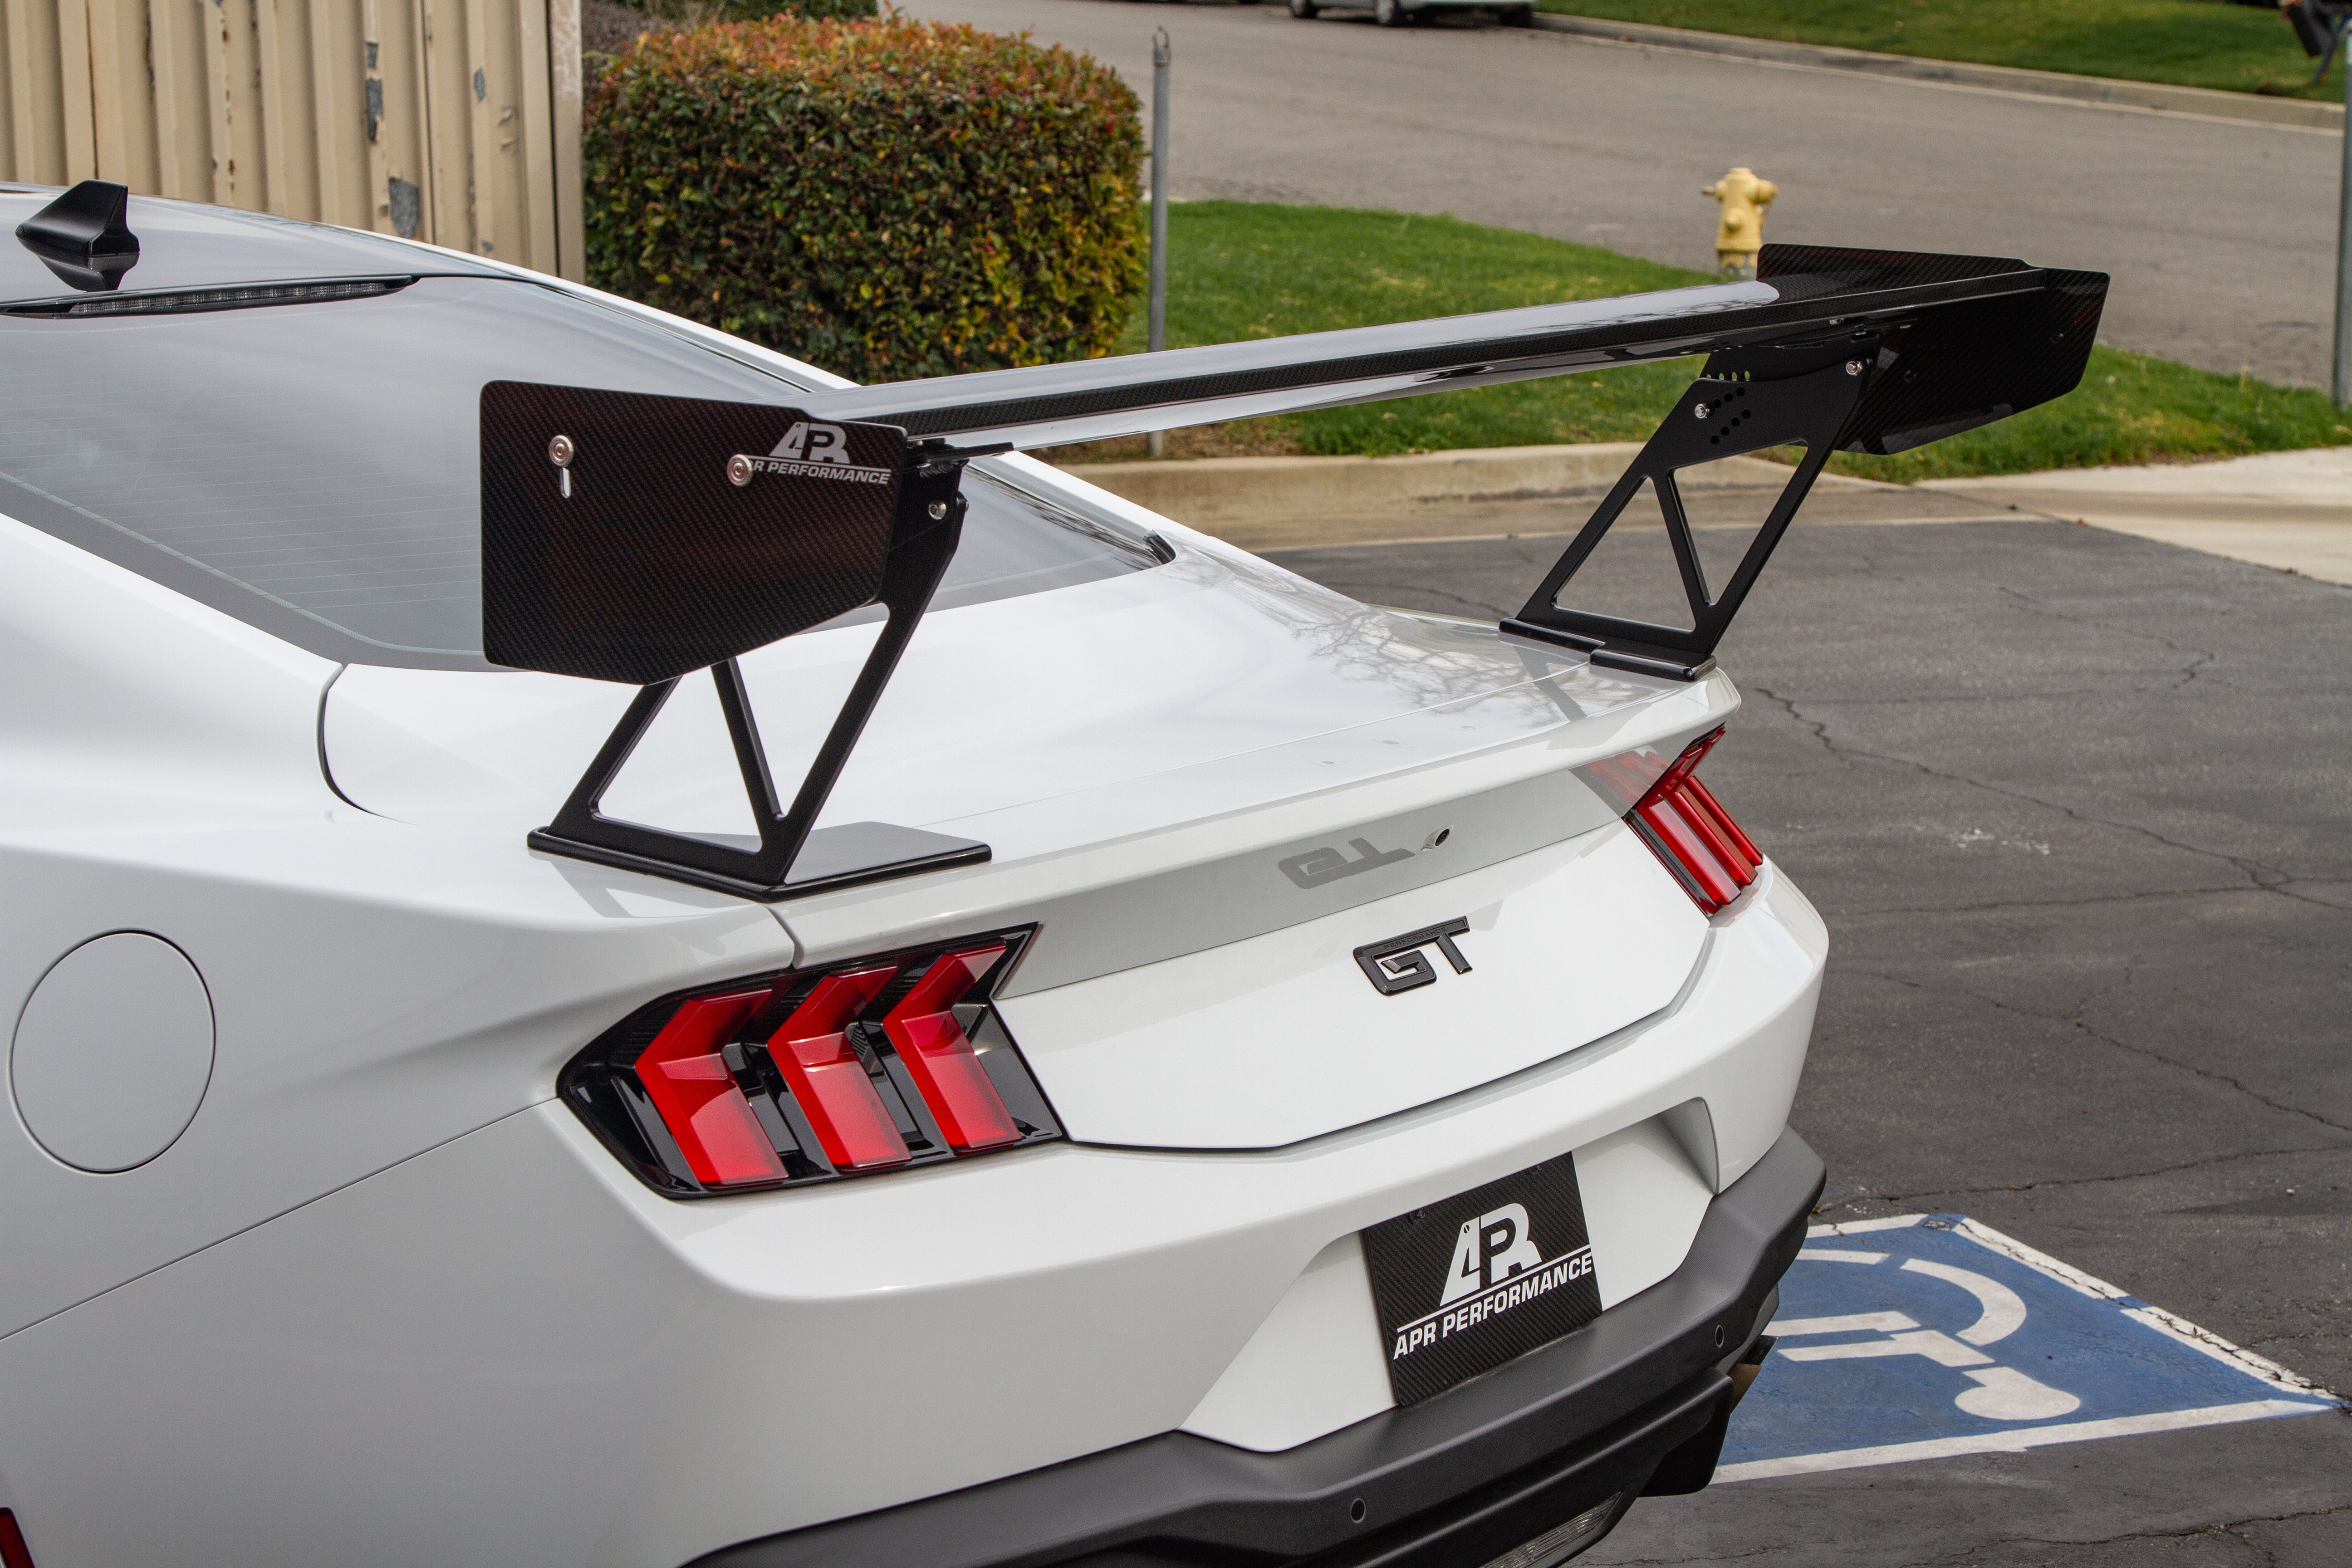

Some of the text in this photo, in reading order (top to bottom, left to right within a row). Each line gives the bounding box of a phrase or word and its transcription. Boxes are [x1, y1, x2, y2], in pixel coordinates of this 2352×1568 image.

[767, 461, 891, 485] PERFORMANCE
[1353, 916, 1473, 996] GT
[1383, 927, 1447, 949] PERFORMANCE
[1393, 1251, 1592, 1360] APR PERFORMANCE
